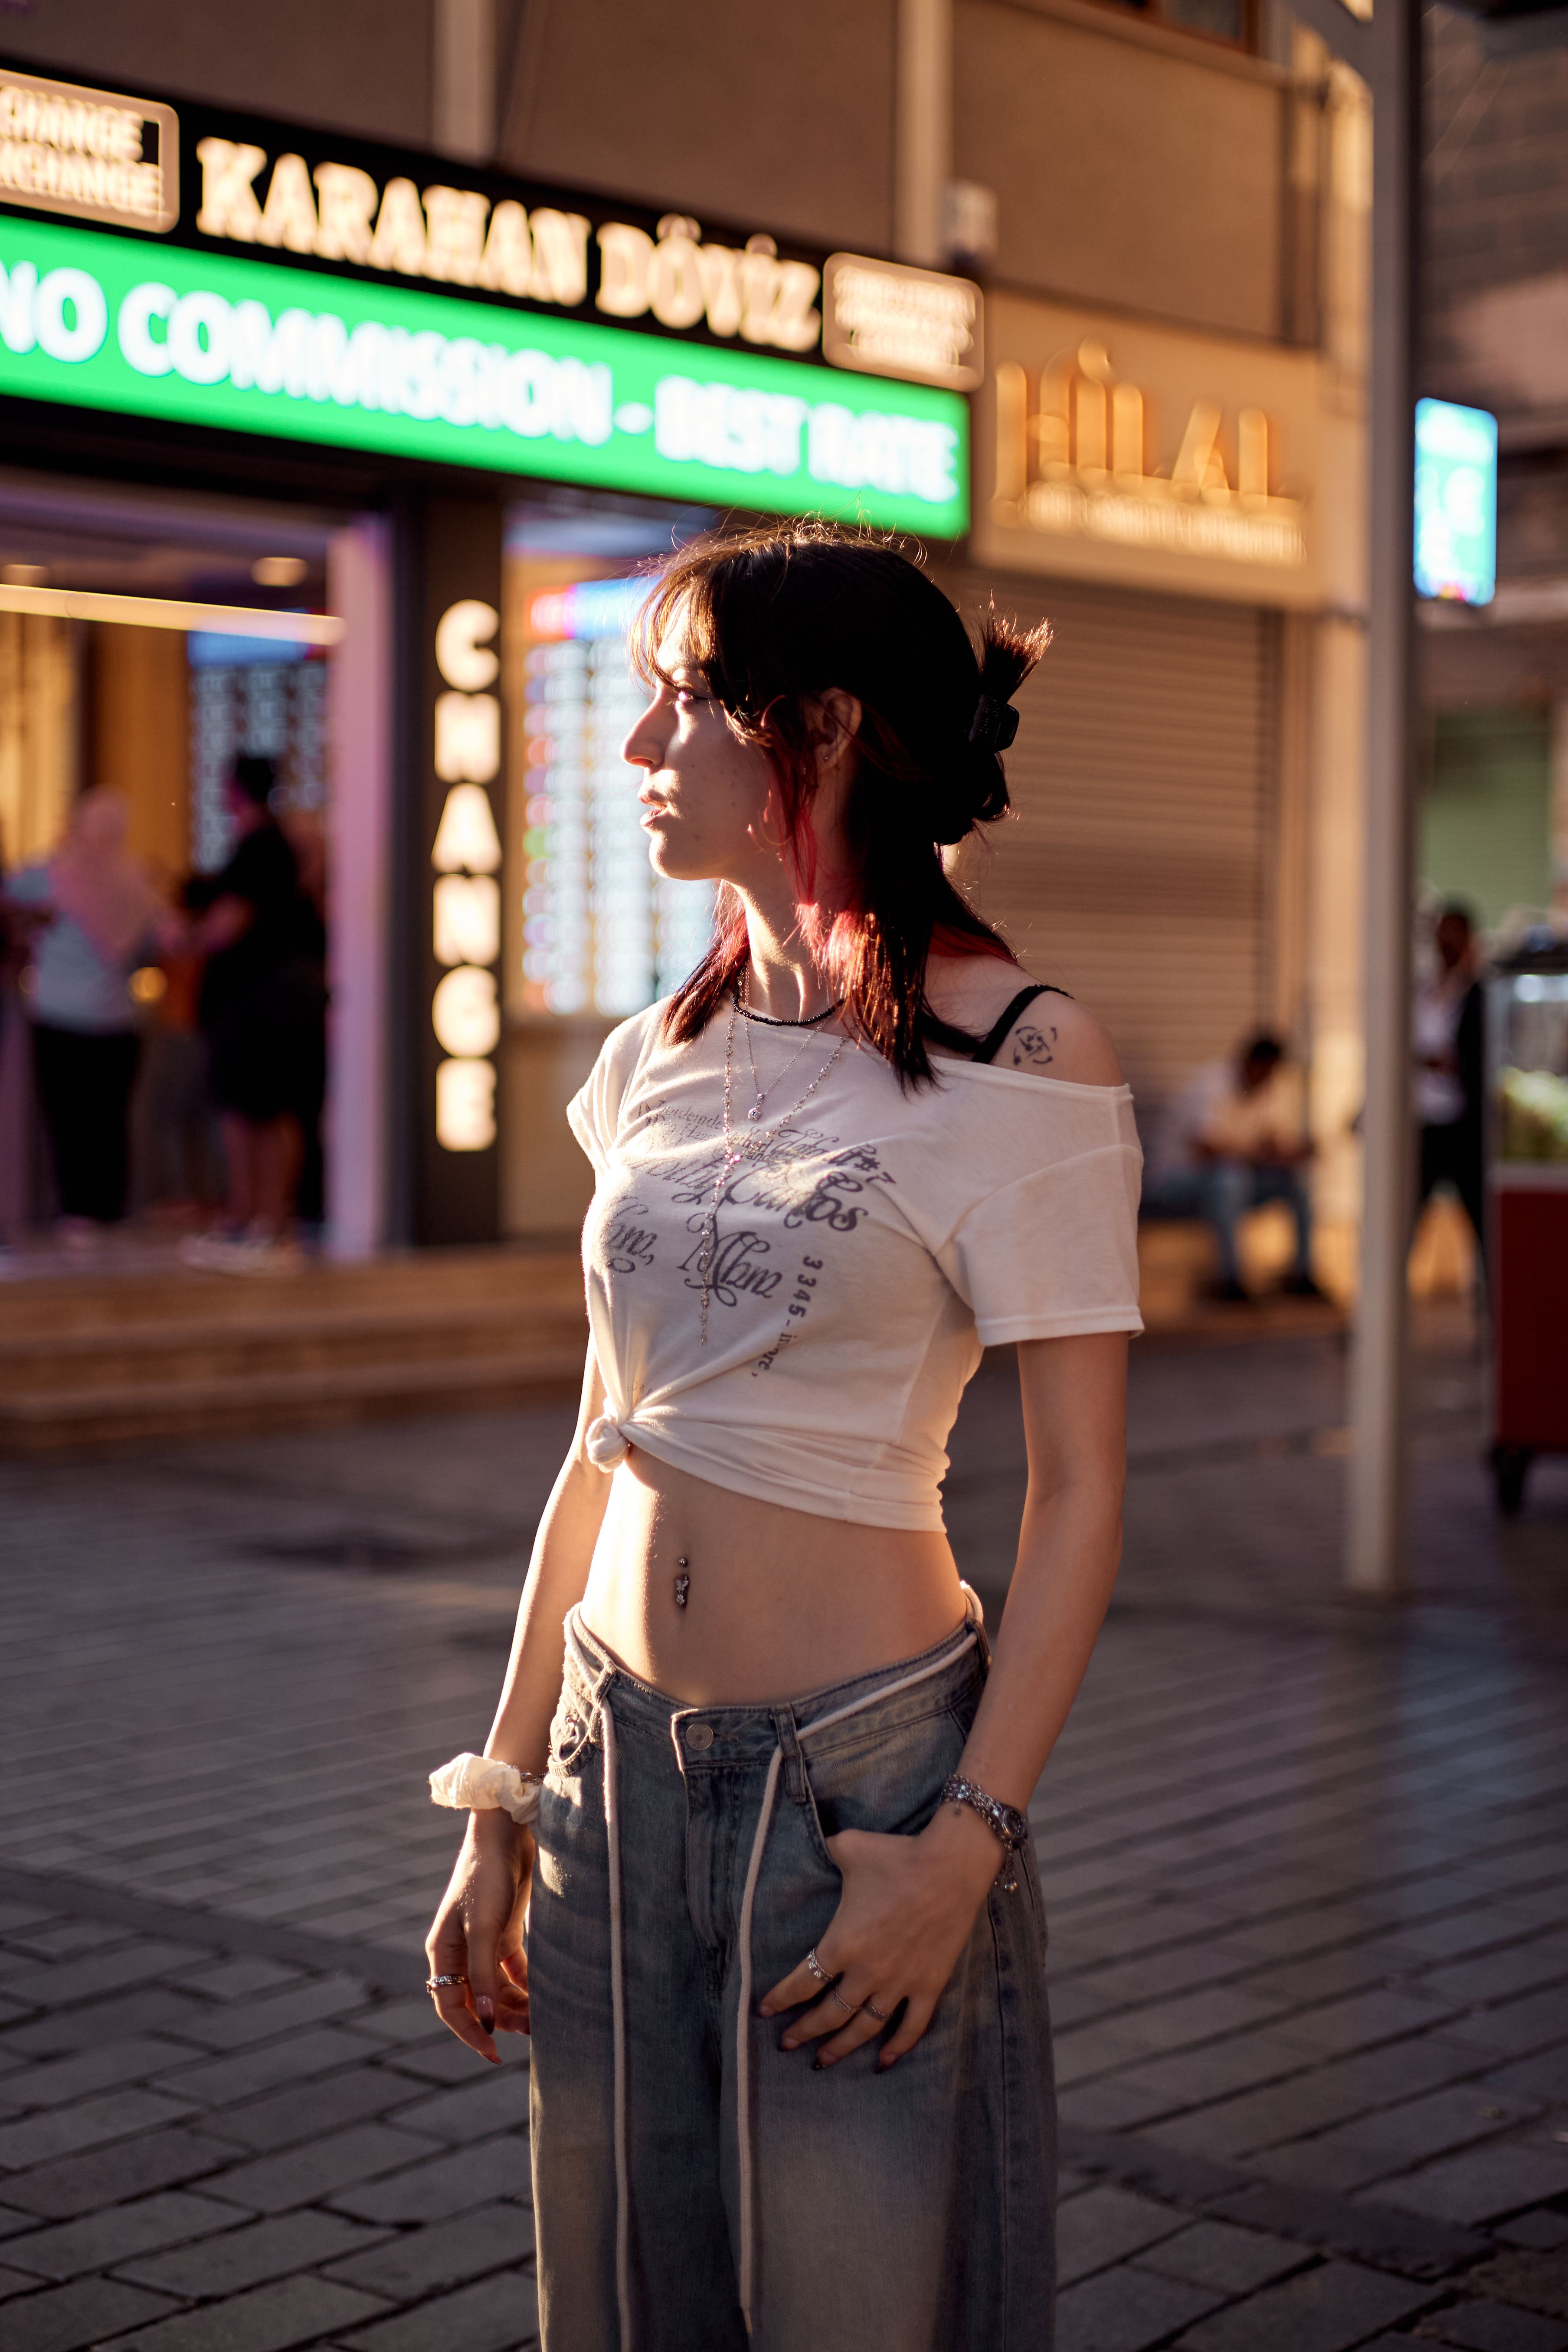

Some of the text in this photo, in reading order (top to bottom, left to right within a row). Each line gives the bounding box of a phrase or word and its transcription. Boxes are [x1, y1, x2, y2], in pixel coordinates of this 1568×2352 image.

[196, 136, 591, 307] KARAHAN
[0, 260, 109, 363] NO
[118, 281, 613, 448] COMMISSION
[655, 375, 809, 478] BEST
[807, 401, 959, 504] RATE
[432, 599, 501, 1151] CHANGE
